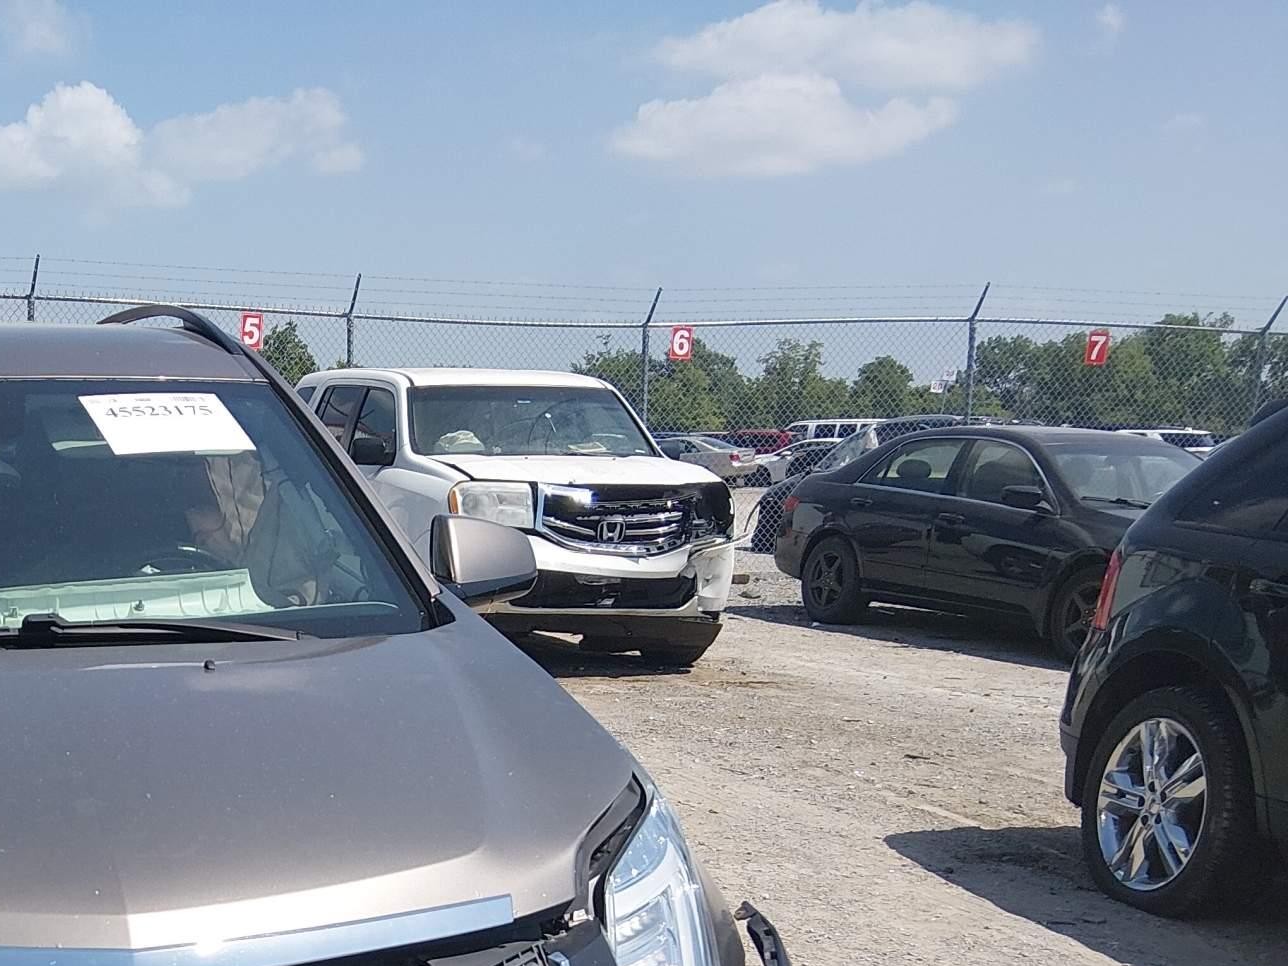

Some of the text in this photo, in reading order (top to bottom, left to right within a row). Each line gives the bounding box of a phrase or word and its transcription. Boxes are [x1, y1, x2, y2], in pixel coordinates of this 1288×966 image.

[243, 317, 260, 345] 5
[673, 330, 690, 356] 6
[1091, 335, 1107, 361] 7
[105, 405, 213, 418] 45523175
